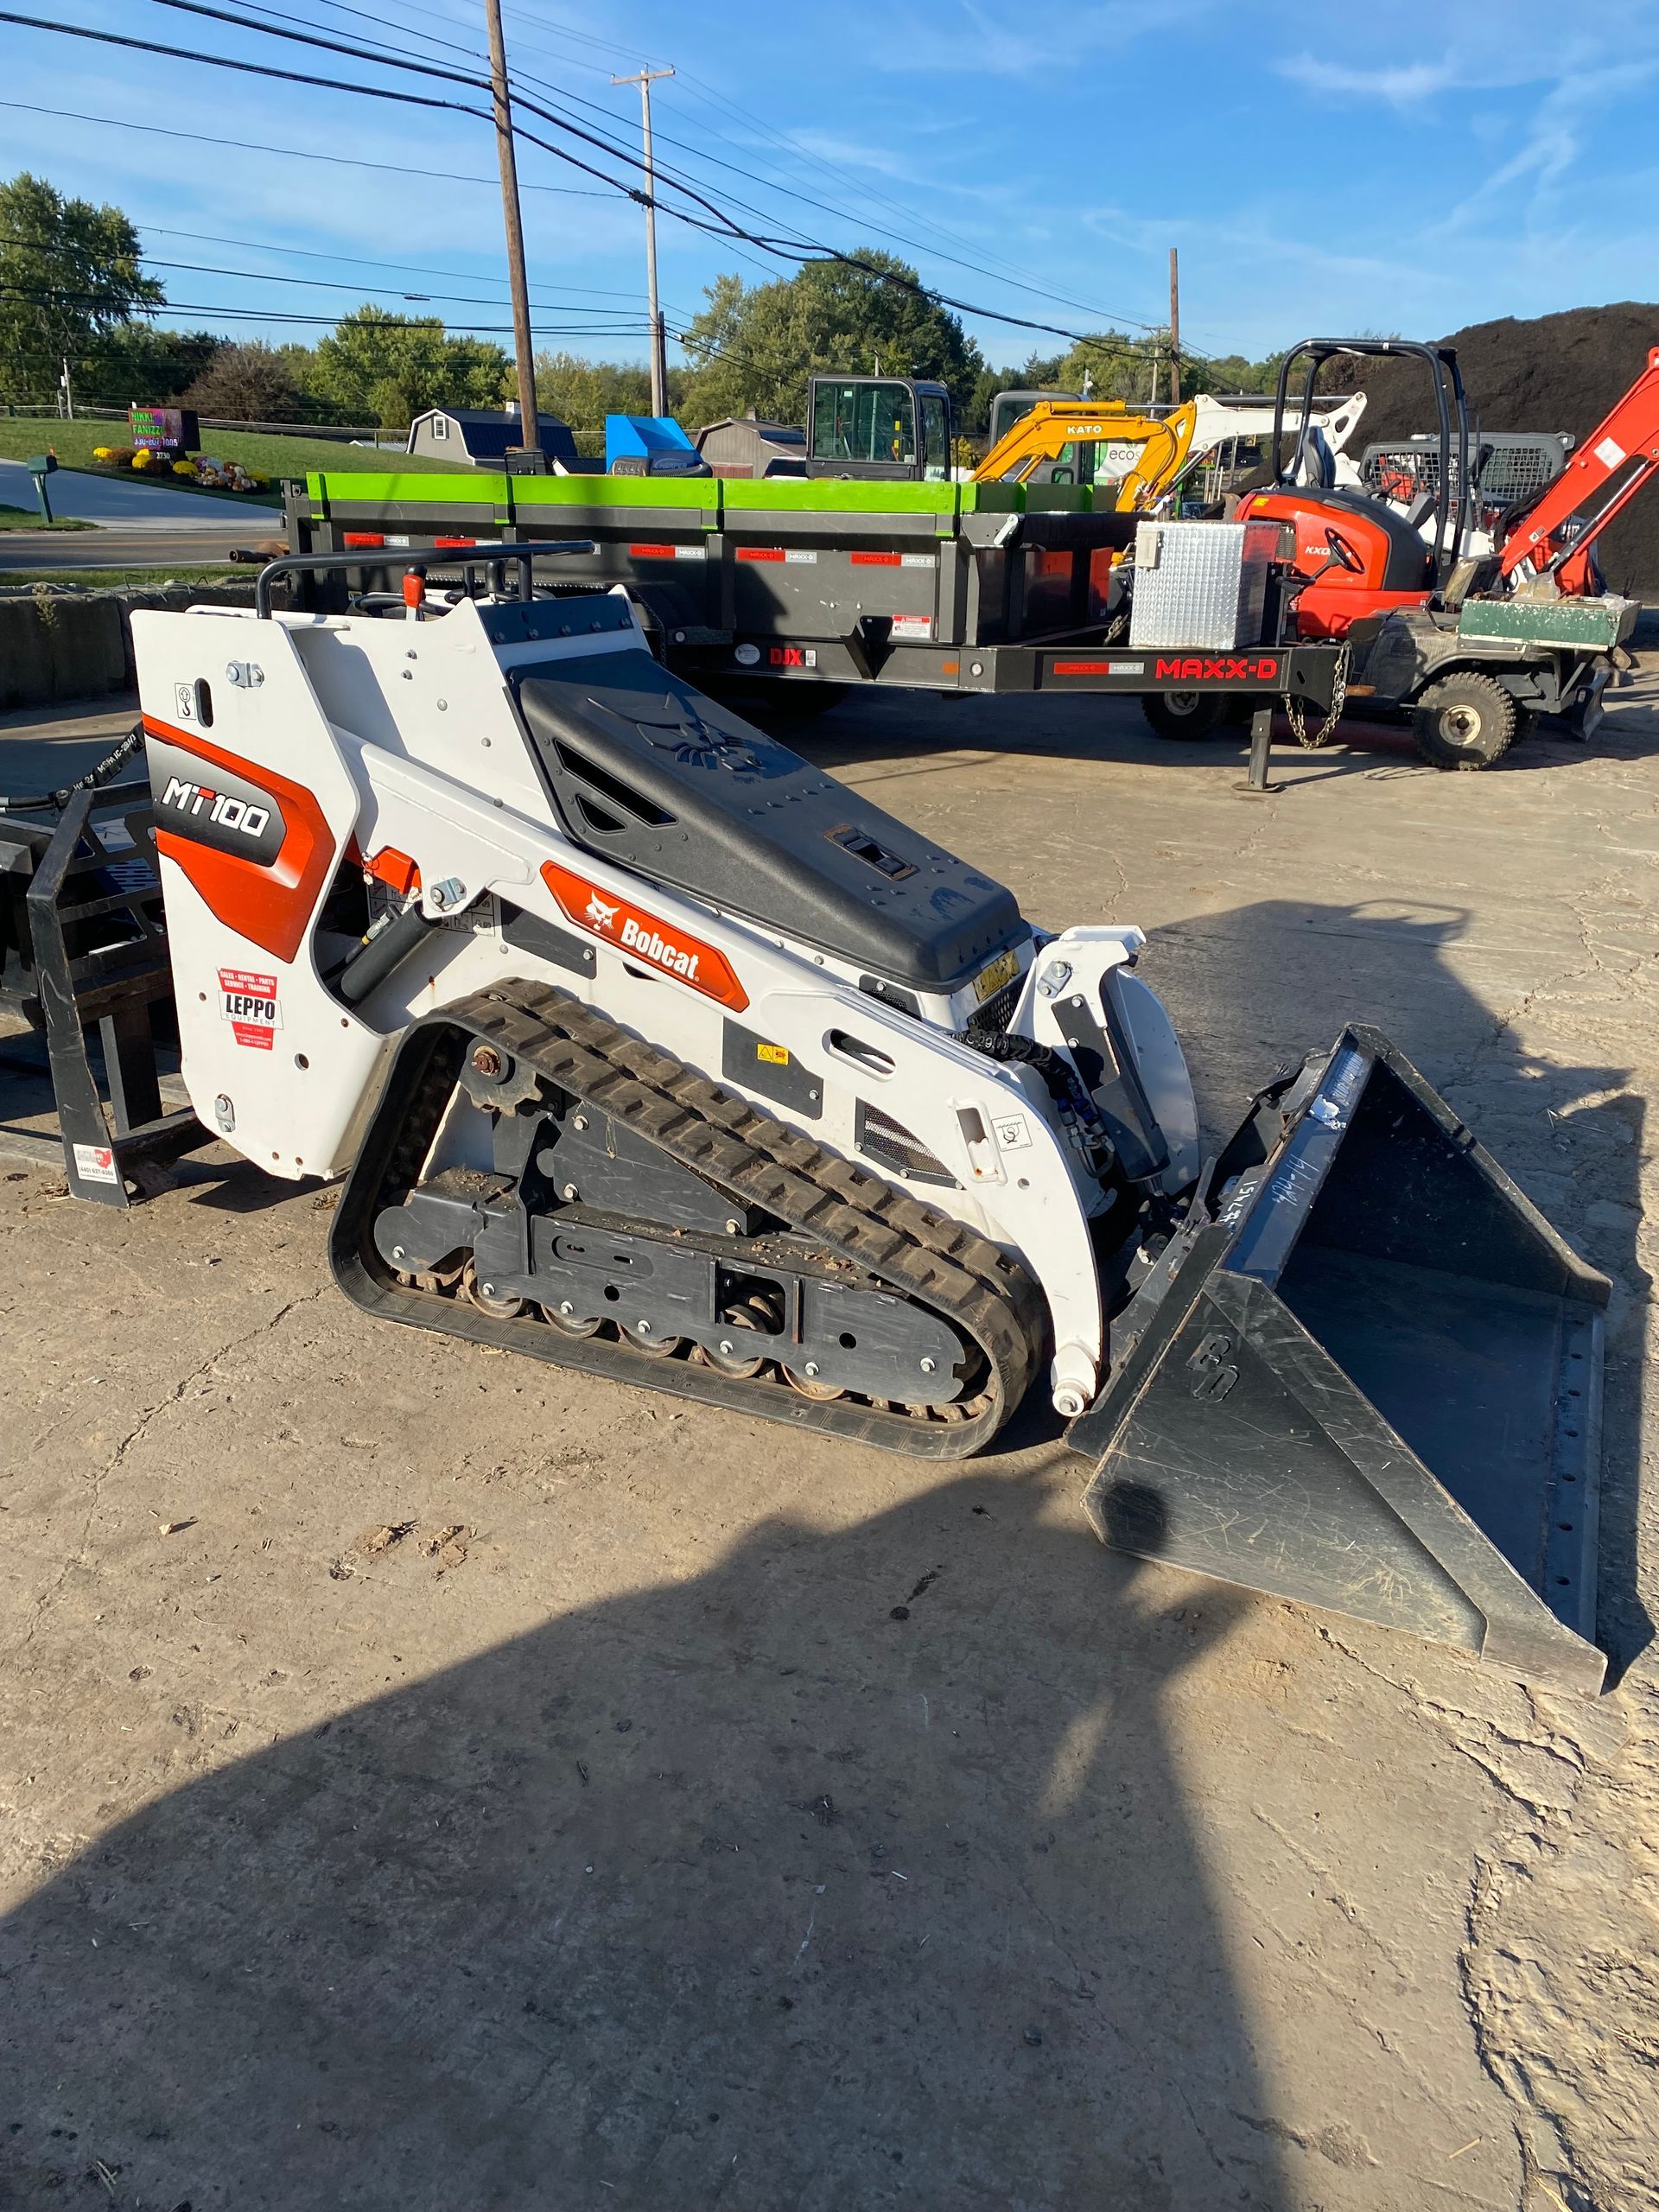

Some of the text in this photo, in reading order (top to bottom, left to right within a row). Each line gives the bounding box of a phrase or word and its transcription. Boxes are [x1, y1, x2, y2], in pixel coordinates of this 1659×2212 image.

[130, 411, 153, 422] NIKKI
[1067, 425, 1103, 434] KATO
[156, 451, 170, 460] 2730
[1109, 449, 1141, 460] ecos
[770, 648, 803, 665] DJX
[1155, 658, 1277, 678] MAXX-D
[161, 776, 270, 838] MT100
[620, 918, 699, 980] Bobcat
[258, 977, 275, 986] PARTS
[226, 994, 276, 1020] LEPPO
[226, 1013, 276, 1027] EQUIPMENT
